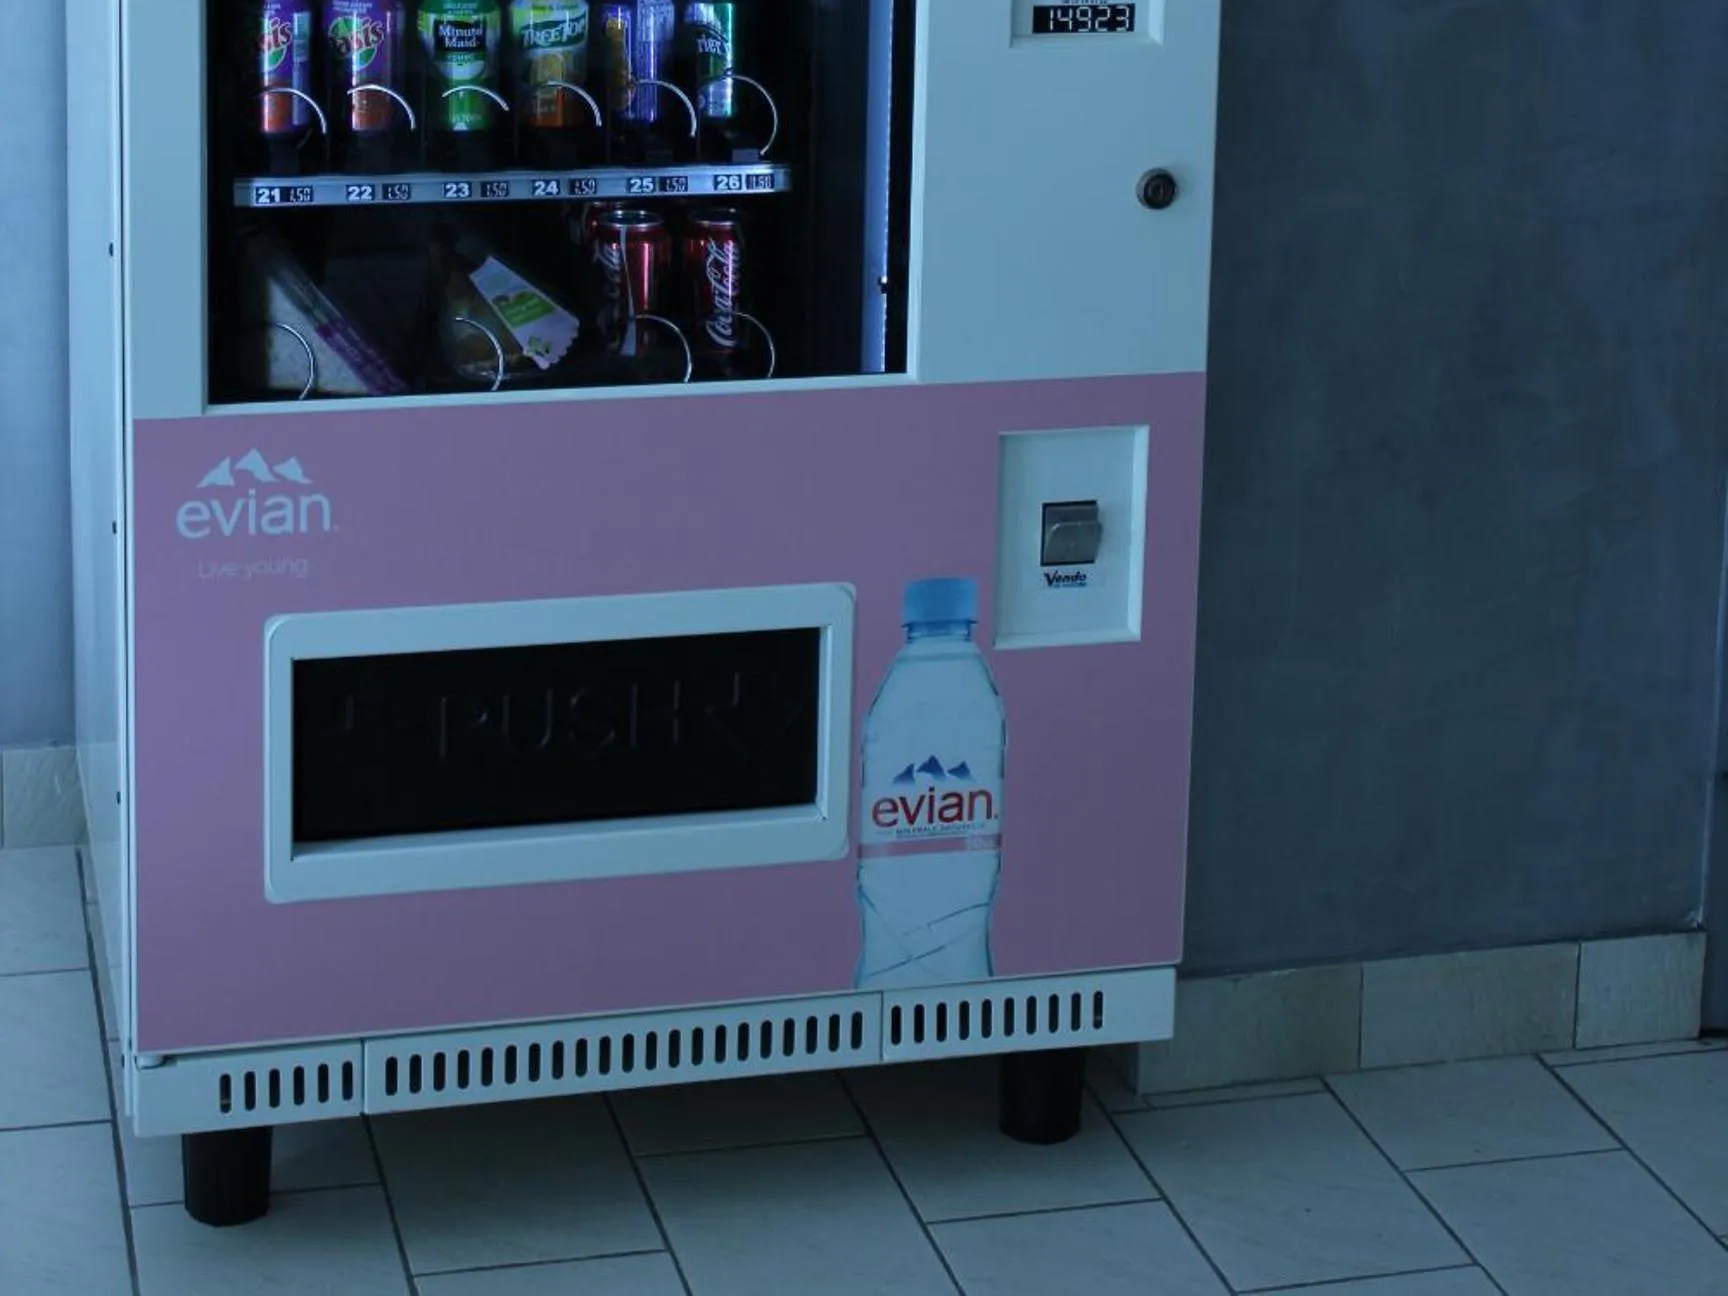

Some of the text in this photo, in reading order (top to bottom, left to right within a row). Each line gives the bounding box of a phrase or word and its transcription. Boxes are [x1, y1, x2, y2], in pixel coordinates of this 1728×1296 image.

[1050, 6, 1130, 32] 14923
[445, 183, 469, 198] 23
[535, 181, 559, 196] 24
[630, 178, 654, 192] 25
[717, 176, 741, 190] 26
[258, 188, 280, 203] 21
[348, 186, 372, 201] 22
[176, 488, 331, 539] evian
[440, 679, 681, 762] PUSH
[872, 785, 993, 828] evian
